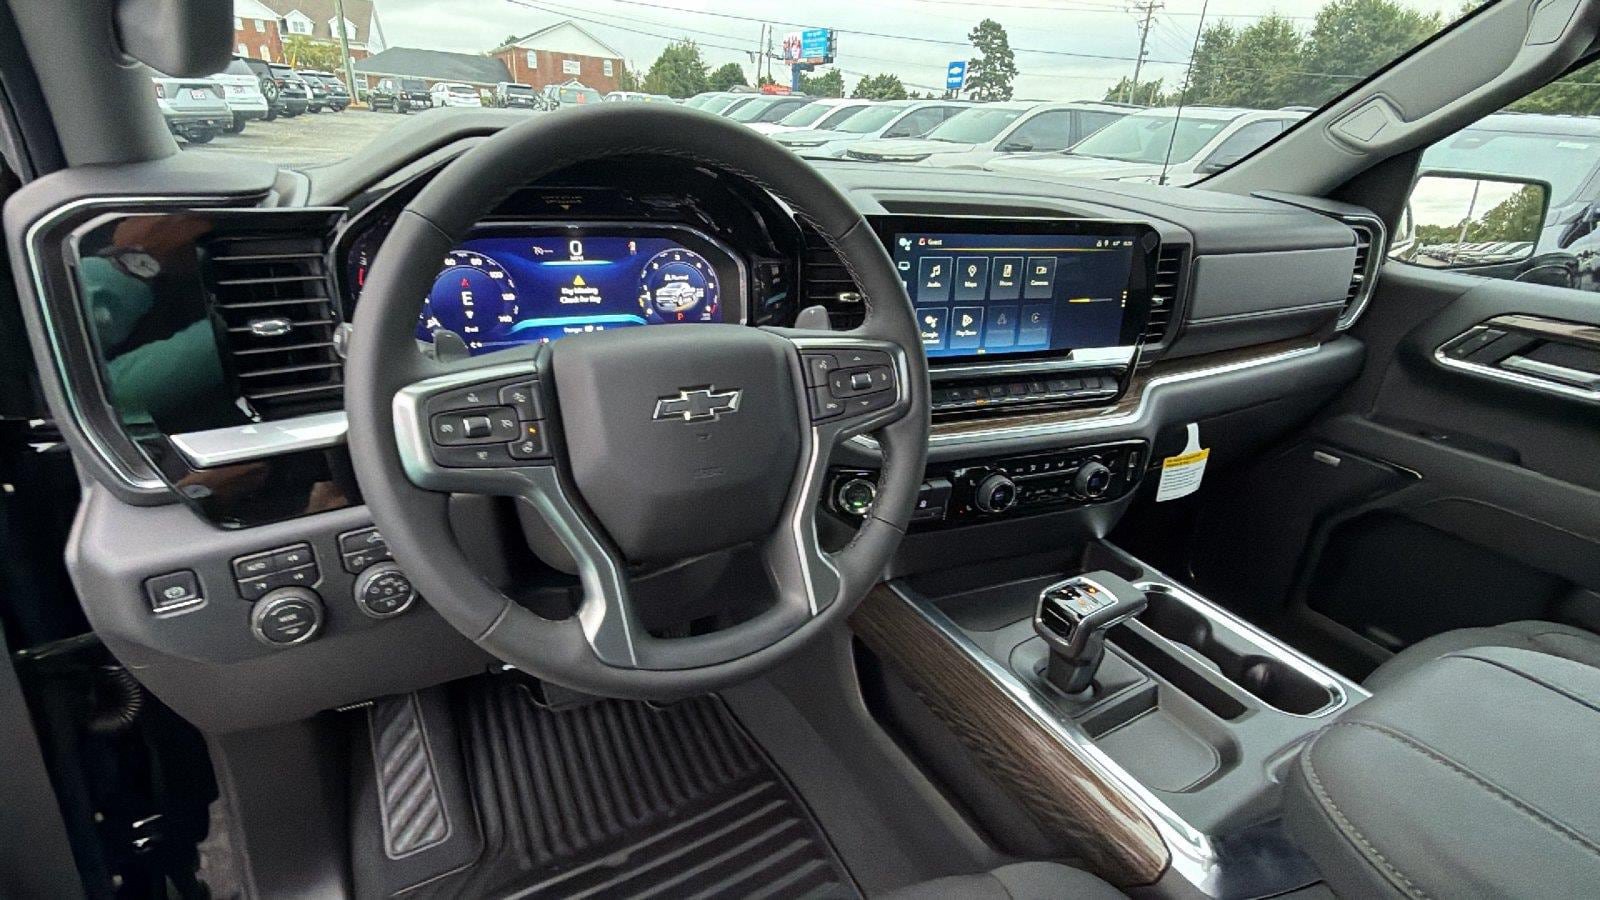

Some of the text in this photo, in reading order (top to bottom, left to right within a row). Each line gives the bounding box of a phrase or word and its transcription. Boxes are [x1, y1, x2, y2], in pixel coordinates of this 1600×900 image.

[569, 240, 583, 256] 0
[461, 291, 474, 306] E
[677, 313, 684, 321] P
